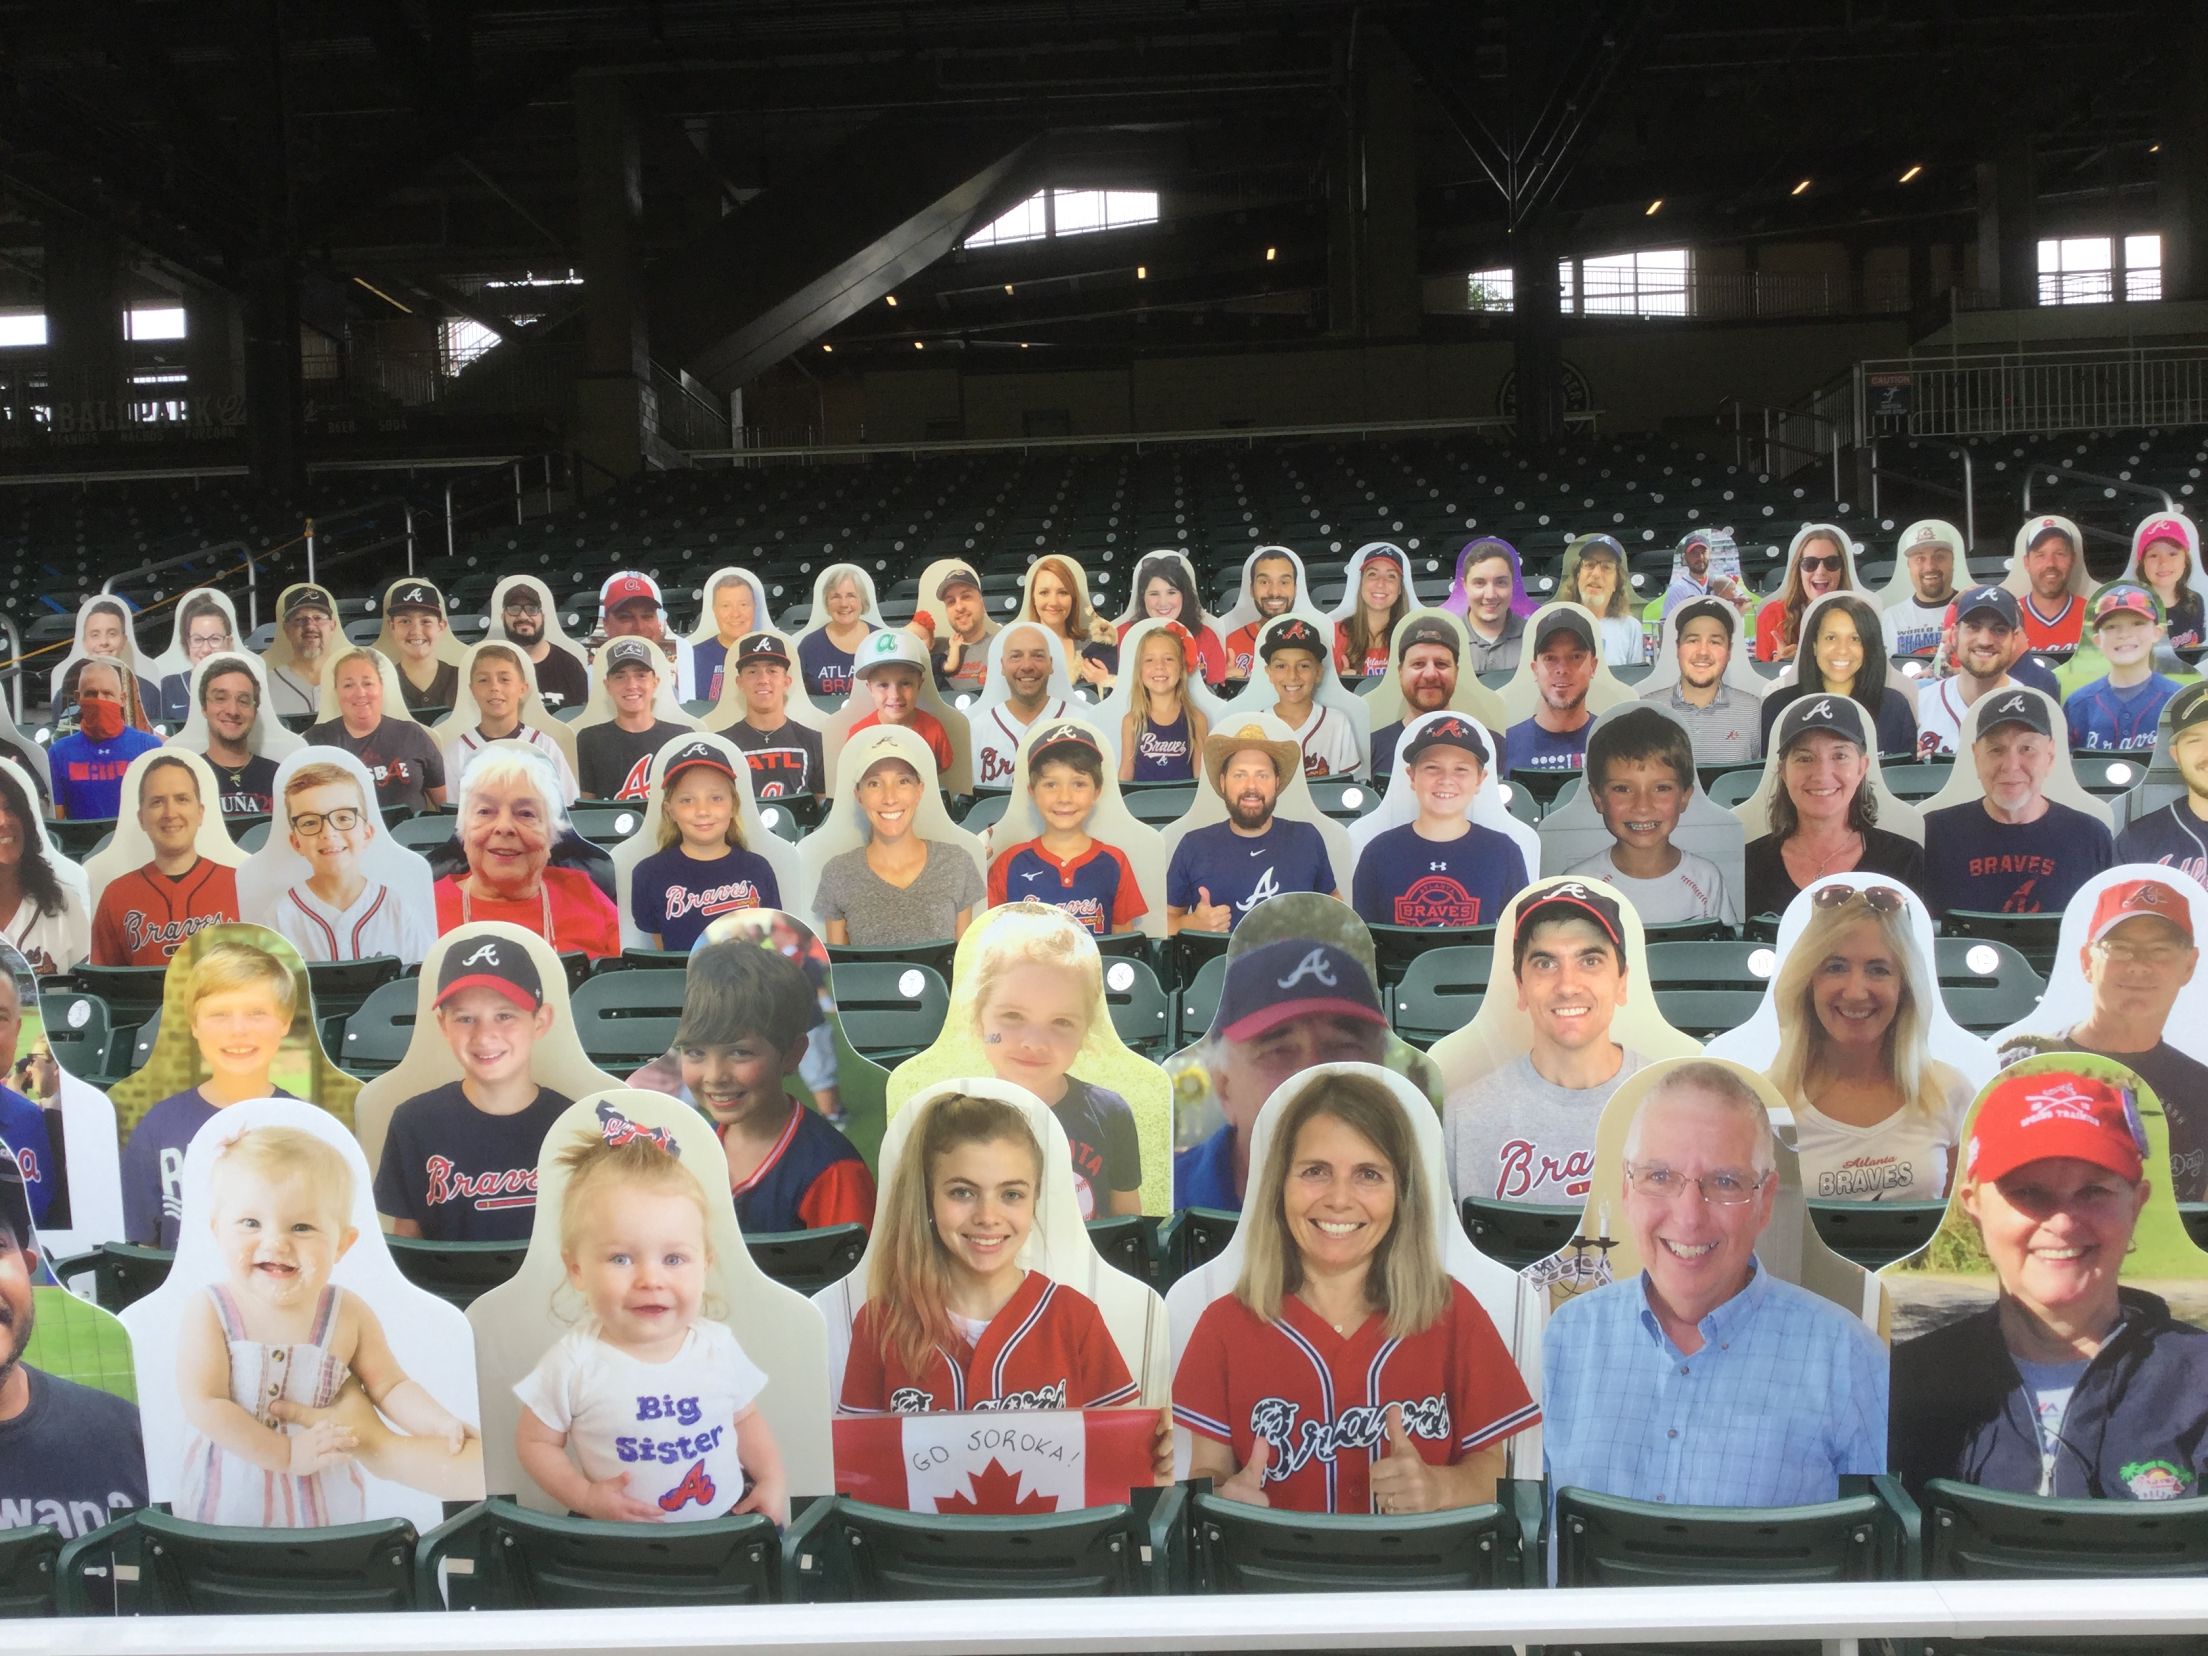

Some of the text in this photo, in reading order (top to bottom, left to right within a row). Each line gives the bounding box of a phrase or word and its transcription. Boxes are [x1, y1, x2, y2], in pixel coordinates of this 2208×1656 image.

[1871, 374, 1911, 386] CAUTION
[1802, 699, 1834, 721] A
[1998, 694, 2025, 713] A
[682, 742, 709, 758] A
[1140, 732, 1188, 755] Braves
[1969, 854, 2057, 876] BRAVES
[665, 880, 750, 920] Braves
[1403, 903, 1472, 918] BRAVES
[462, 943, 500, 967] A
[1276, 947, 1338, 990] A
[1843, 1155, 1898, 1169] Atlanta
[1819, 1162, 1913, 1197] BRAVES
[636, 1393, 702, 1427] Big
[615, 1424, 723, 1465] Sister
[912, 1429, 1080, 1471] GO SOROKA!
[657, 1457, 716, 1512] A
